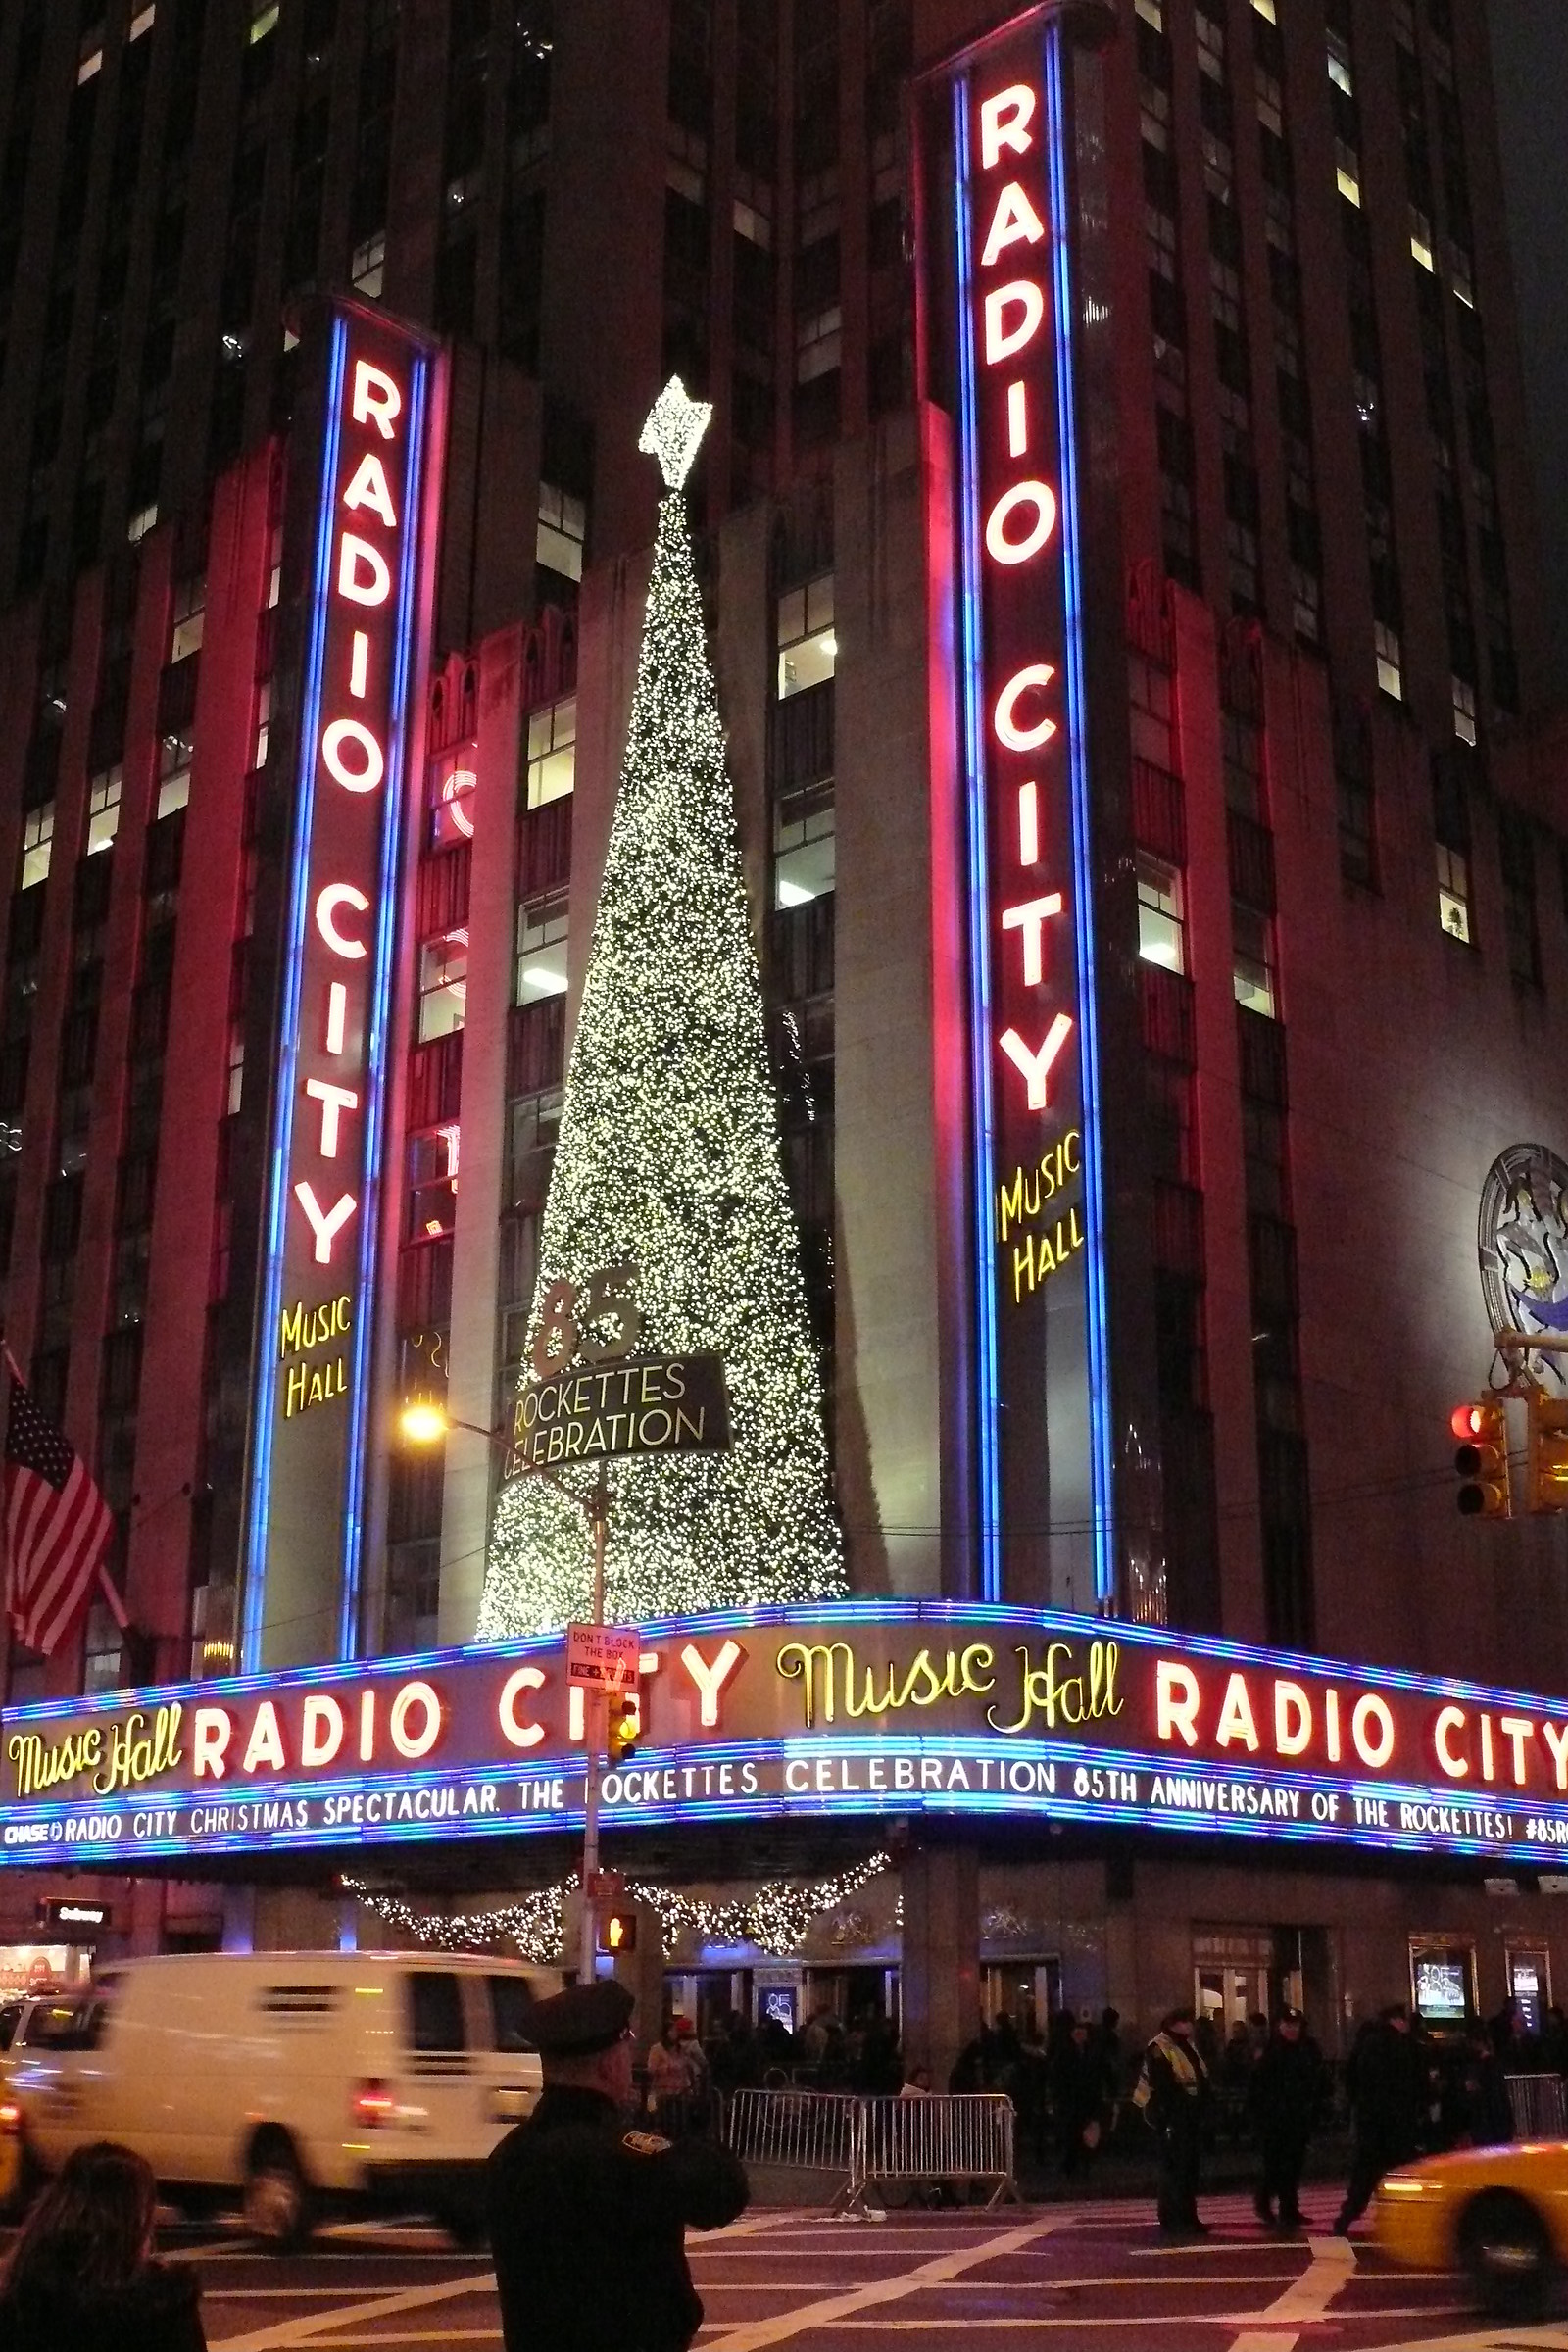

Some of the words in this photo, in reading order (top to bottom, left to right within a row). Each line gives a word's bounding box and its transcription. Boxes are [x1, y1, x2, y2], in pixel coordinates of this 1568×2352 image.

[981, 83, 1056, 565] RADIO
[322, 360, 402, 793] RADIO
[994, 663, 1073, 1111] CITY
[294, 882, 370, 1264] CITY
[533, 1263, 641, 1378] 85
[504, 1406, 705, 1481] CELEBRATION
[514, 1363, 686, 1436] ROCKETTES
[573, 1631, 601, 1644] DONT
[604, 1636, 635, 1649] BLOCK
[584, 1645, 603, 1658] THE
[606, 1648, 623, 1660] BOX
[8, 1728, 101, 1797] Music
[93, 1700, 183, 1795] Hall
[194, 1680, 441, 1779] RADIO
[776, 1642, 996, 1729] Music
[987, 1641, 1125, 1734] Hall
[1156, 1659, 1395, 1768] RADIO
[1434, 1705, 1568, 1789] CITY
[4, 1824, 49, 1844] CHASE
[65, 1816, 122, 1843] RADIO
[133, 1809, 178, 1839] CITY
[190, 1799, 309, 1835] CHRISTMAS
[518, 1779, 564, 1810] THE
[585, 1762, 759, 1805] OCKETTES
[785, 1758, 1056, 1794] CELEBRATION
[1073, 1766, 1138, 1803] 85TH
[1151, 1775, 1300, 1819] ANNIVERSARY
[1311, 1792, 1340, 1822] OF
[1353, 1797, 1388, 1829] THE
[1400, 1801, 1513, 1839] ROCKETTES!
[1526, 1818, 1568, 1844] #85R
